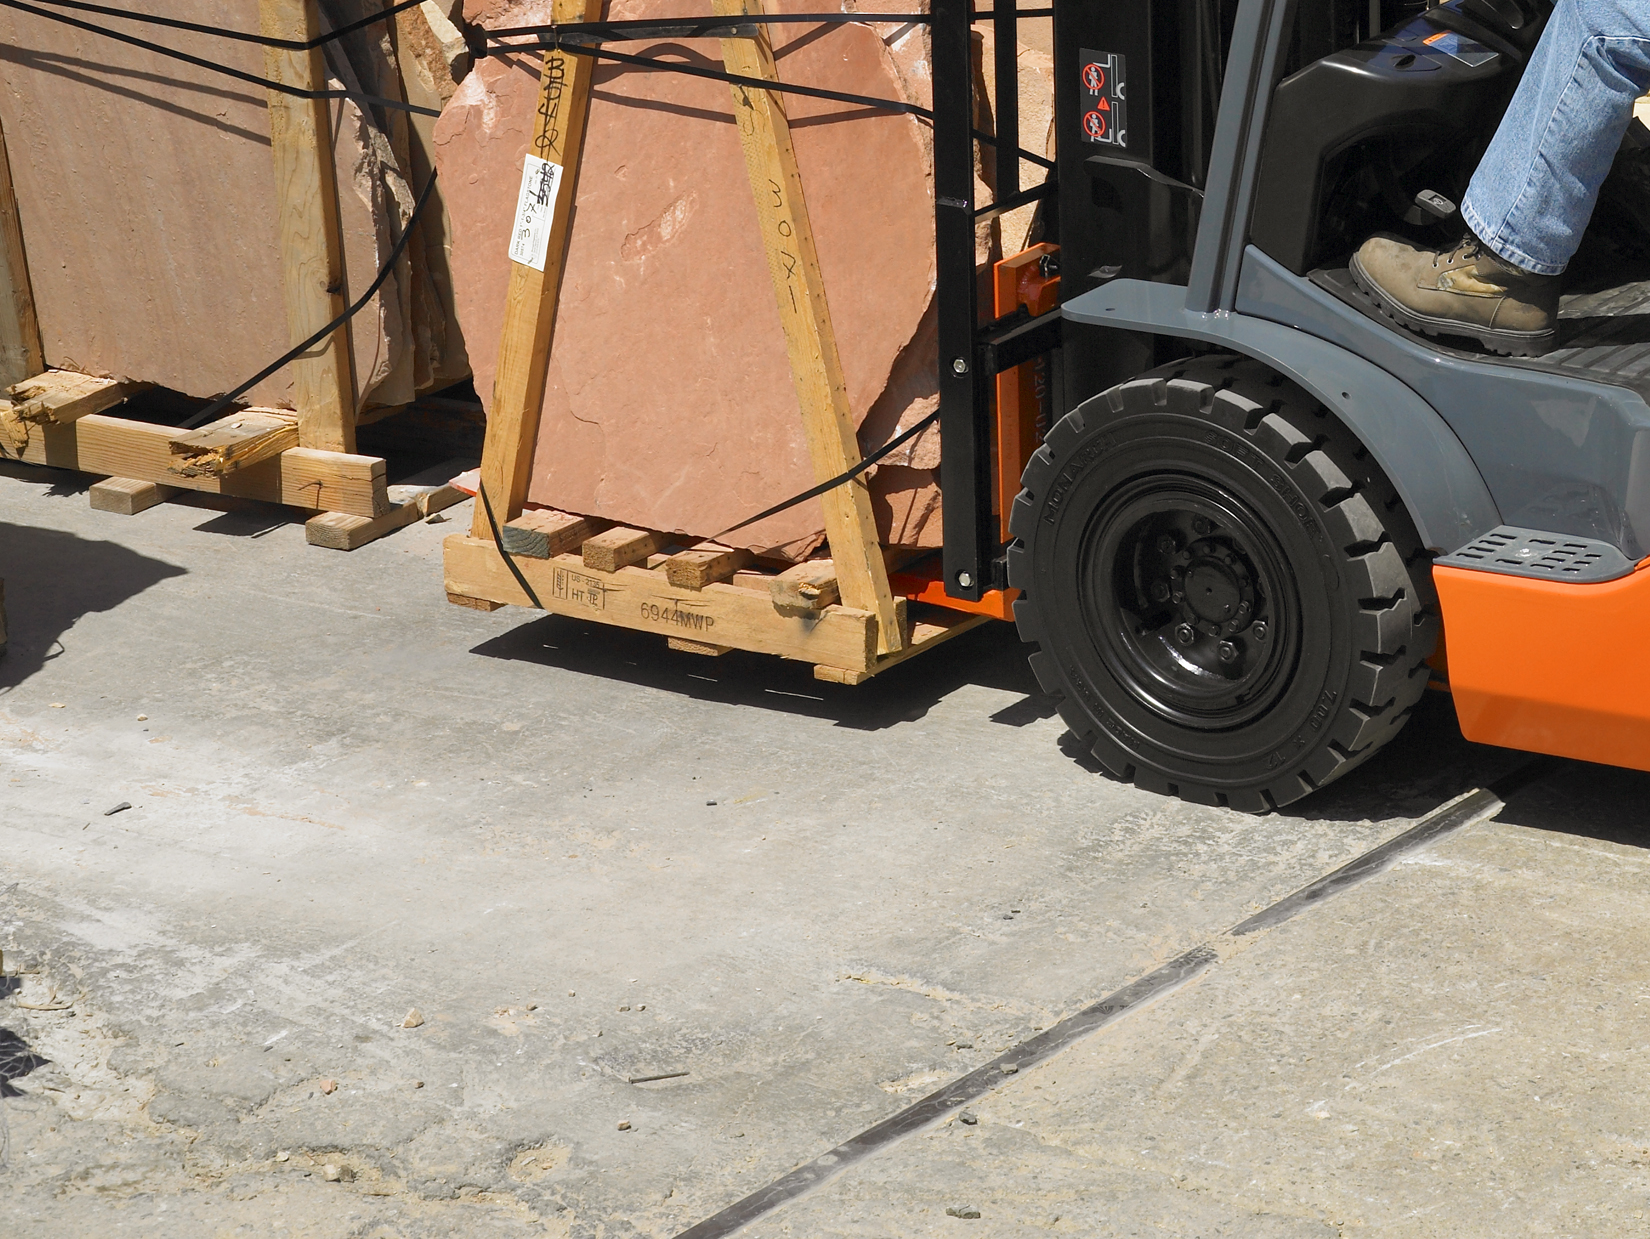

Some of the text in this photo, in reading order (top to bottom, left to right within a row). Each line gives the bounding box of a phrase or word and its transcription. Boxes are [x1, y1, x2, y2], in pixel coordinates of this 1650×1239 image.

[1204, 429, 1264, 470] SOFT
[1043, 432, 1117, 526] MONARCH
[571, 588, 585, 602] HT
[640, 602, 715, 632] 6944MWP
